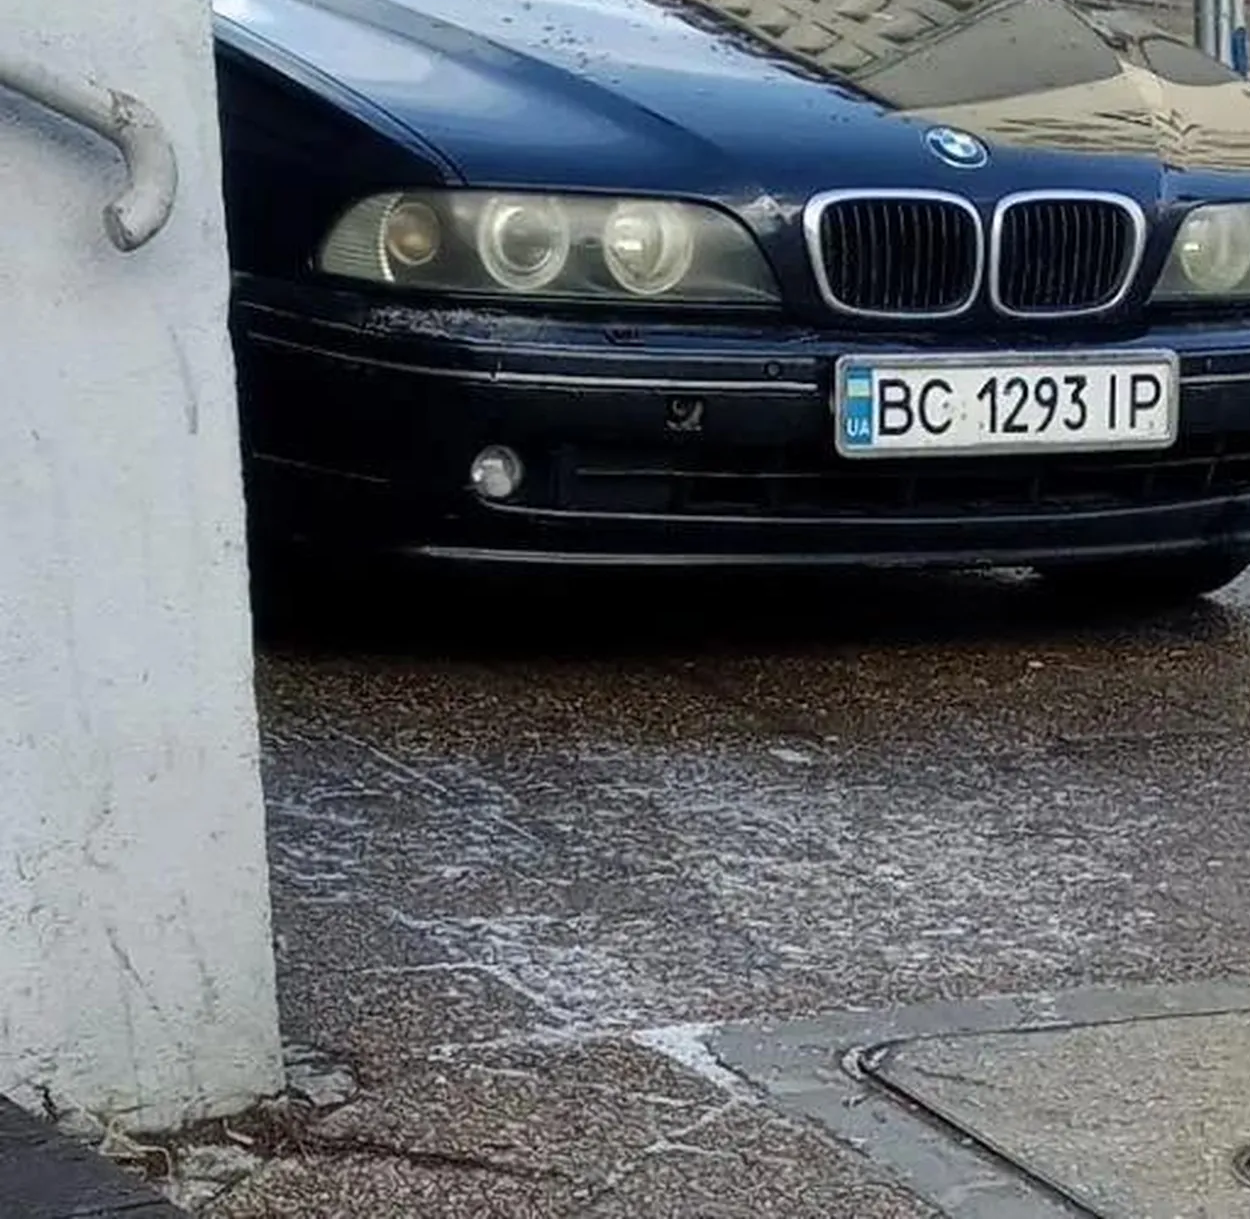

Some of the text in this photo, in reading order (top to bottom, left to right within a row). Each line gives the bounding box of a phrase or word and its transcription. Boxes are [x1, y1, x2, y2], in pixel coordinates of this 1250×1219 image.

[878, 374, 1162, 436] BC 1293 IP
[847, 418, 870, 437] UA
